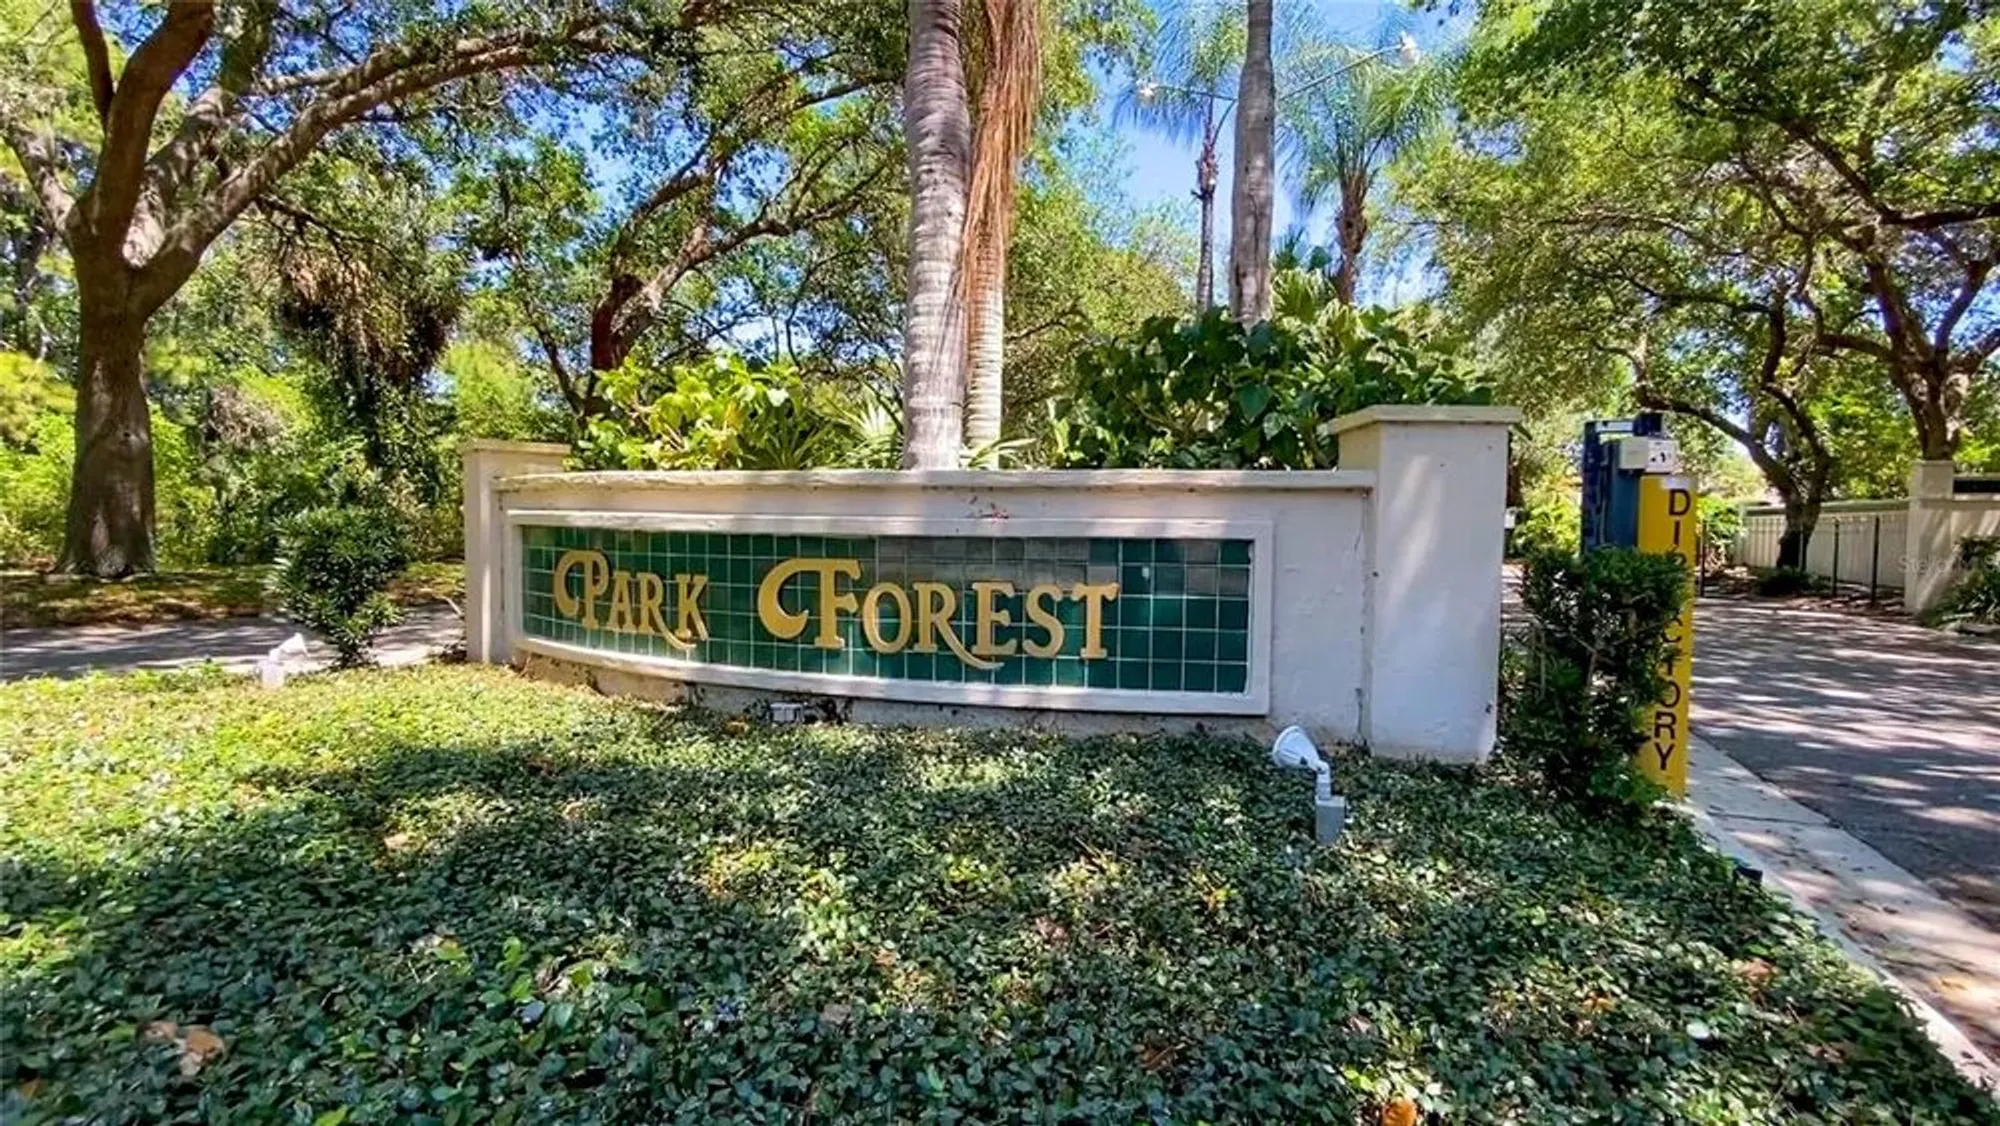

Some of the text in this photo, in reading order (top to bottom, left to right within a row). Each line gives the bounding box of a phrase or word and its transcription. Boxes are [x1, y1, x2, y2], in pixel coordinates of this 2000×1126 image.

[553, 549, 1120, 671] PARK FOREST
[1654, 488, 1692, 771] DICTORY
